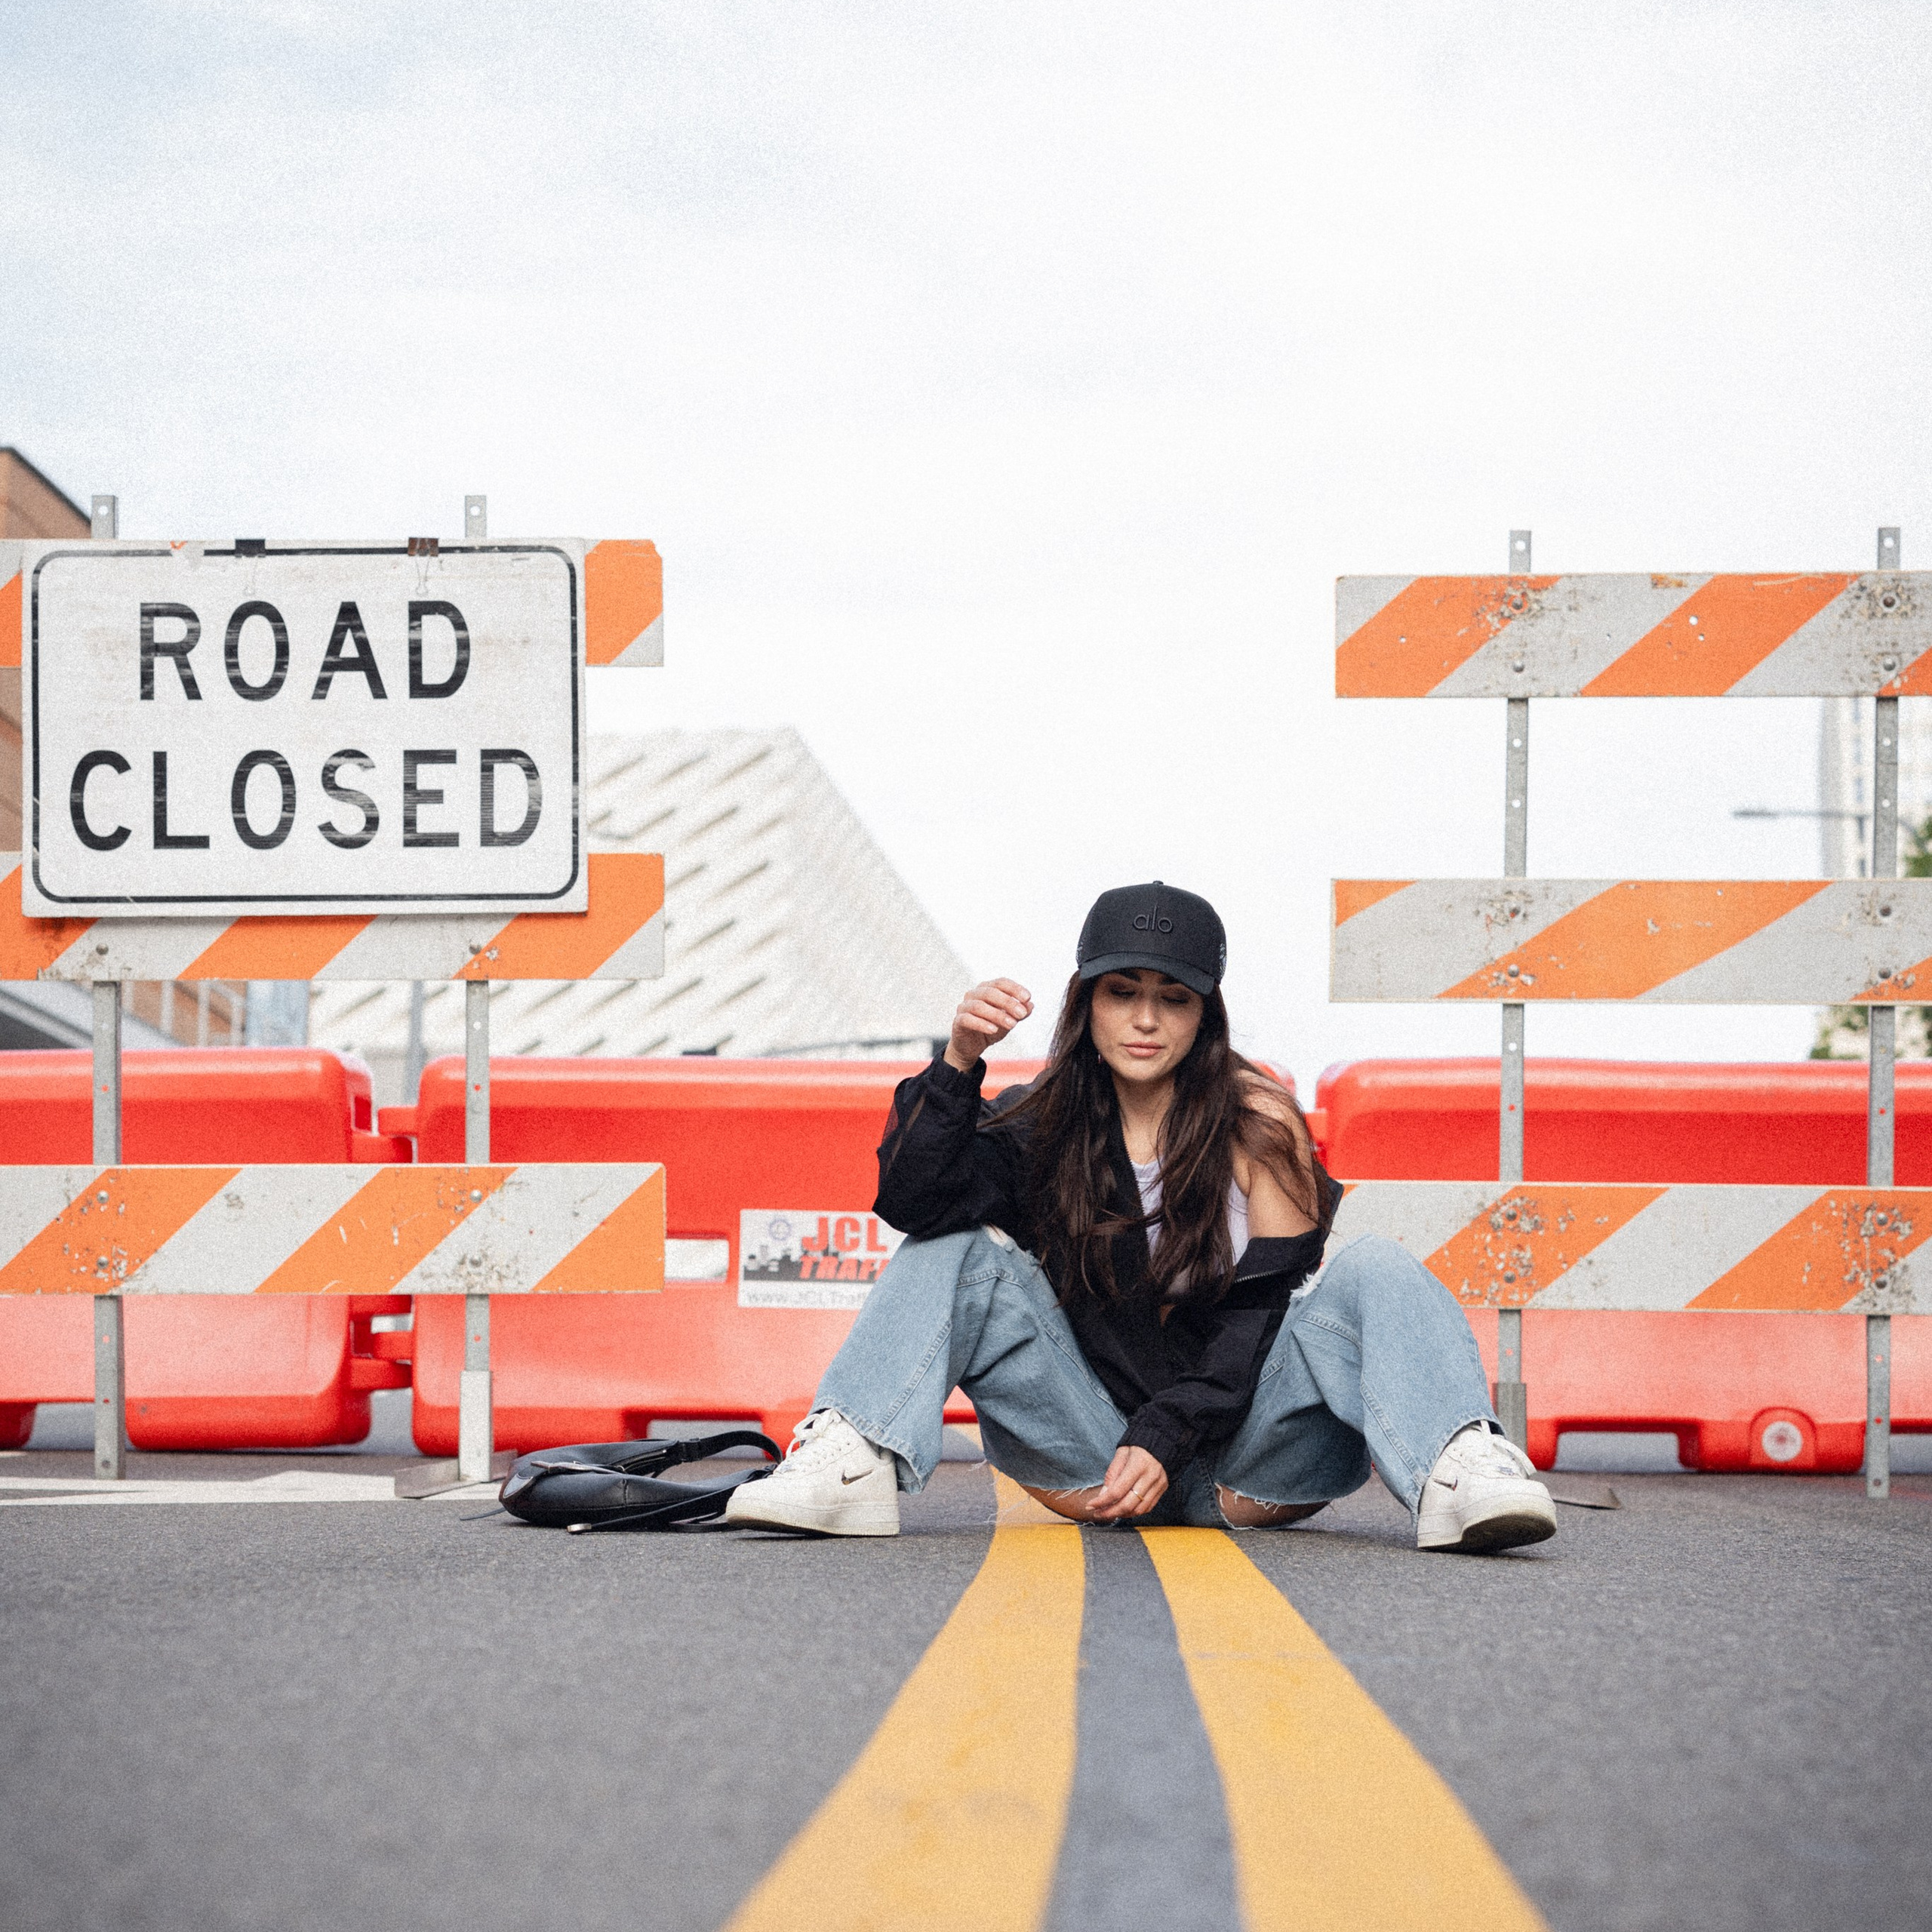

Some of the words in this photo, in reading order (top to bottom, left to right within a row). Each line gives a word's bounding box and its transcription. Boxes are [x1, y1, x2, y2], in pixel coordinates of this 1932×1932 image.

[140, 601, 471, 701] ROAD
[69, 749, 543, 851] CLOSED
[1134, 906, 1173, 933] alo
[801, 1217, 888, 1252] JCL
